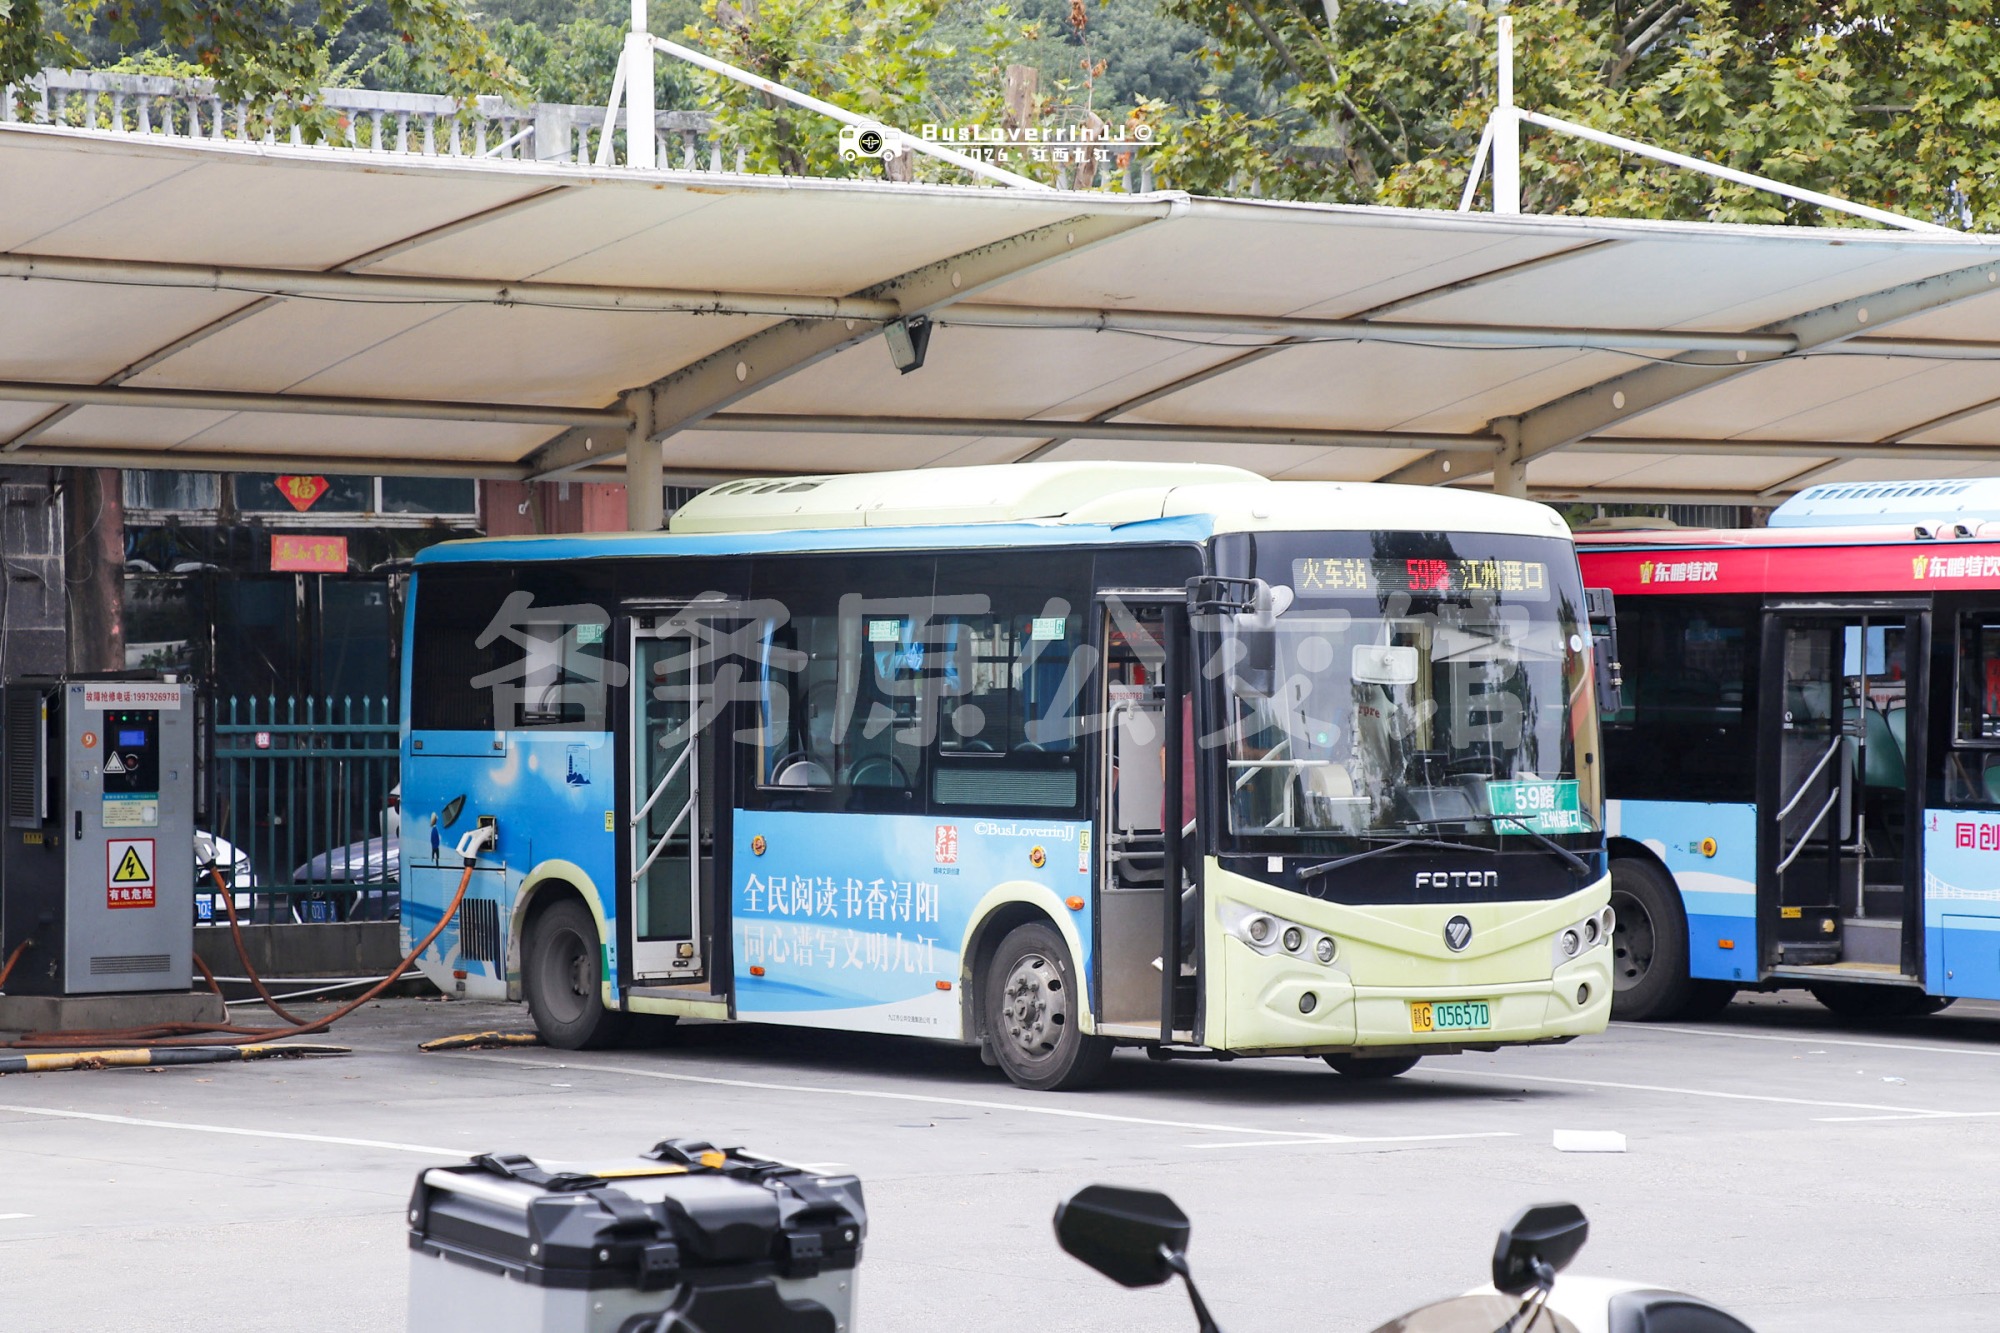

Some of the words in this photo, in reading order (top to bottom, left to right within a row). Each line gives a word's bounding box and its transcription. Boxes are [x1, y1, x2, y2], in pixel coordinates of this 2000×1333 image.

[288, 475, 317, 499] 福
[1303, 558, 1368, 590] 火车站
[1460, 558, 1544, 591] 江州渡口
[1654, 561, 1719, 583] 东鹏特饮
[1929, 555, 2000, 578] 东鹏特饮
[85, 734, 93, 745] 9
[1515, 785, 1555, 810] 59路
[1956, 822, 2000, 851] 同创
[1416, 870, 1498, 888] FOTON
[109, 887, 153, 901] 有电危险
[743, 873, 939, 923] 全民阅读书香浔阳
[744, 925, 941, 975] 同心谱写文明九江
